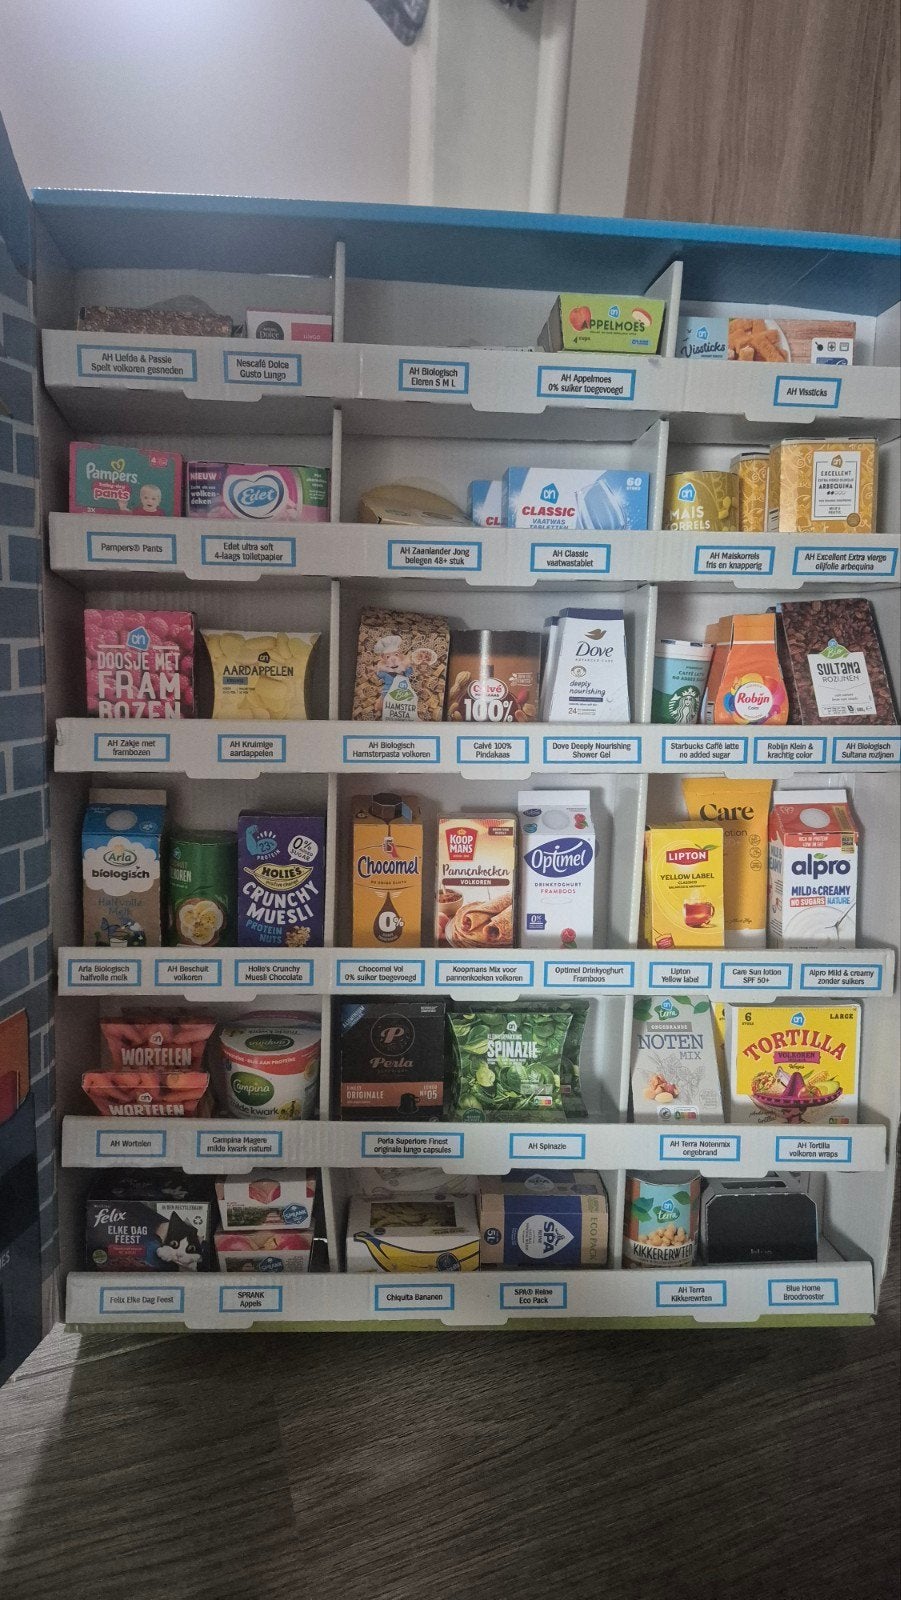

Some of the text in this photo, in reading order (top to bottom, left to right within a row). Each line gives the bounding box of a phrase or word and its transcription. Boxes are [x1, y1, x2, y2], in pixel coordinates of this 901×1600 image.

[581, 319, 645, 333] APPELMOES
[681, 343, 726, 358] Vissticks
[239, 370, 286, 381] Gusto Lungo
[560, 374, 611, 384] AH Appelmoes
[560, 384, 582, 392] suiker
[583, 385, 623, 395] toegevoegd
[798, 388, 827, 396] Vissticks
[86, 462, 138, 484] Pampers
[190, 472, 217, 481] NIEUW
[627, 478, 642, 487] 60
[94, 488, 131, 501] pants
[241, 487, 274, 503] Edet
[521, 506, 576, 517] CLASSIC
[670, 506, 704, 520] MAIS
[452, 547, 469, 556] Jong
[564, 550, 588, 558] Classic
[242, 553, 283, 562] toiletpapier
[405, 557, 432, 566] belegen
[449, 557, 464, 565] stuk
[546, 559, 593, 567] vaatwastablet
[575, 640, 614, 658] Dove
[98, 651, 180, 670] DOOSJE MET
[223, 665, 294, 677] AARDAPPELEN
[822, 675, 860, 683] ROZIJNEN
[99, 672, 181, 700] FRAM
[569, 680, 591, 689] deeply
[569, 686, 606, 697] nourishing
[737, 692, 770, 706] Robijn
[99, 701, 181, 719] BOZEN
[385, 702, 417, 712] HAMSTER
[464, 699, 513, 722] 100%
[389, 710, 416, 719] PASTA
[120, 740, 139, 749] Zakje
[242, 741, 272, 749] Kruimige
[380, 742, 414, 751] Biologisch
[571, 742, 593, 751] Deeply
[595, 742, 630, 751] Nourishing
[767, 743, 787, 752] Robijn
[857, 743, 890, 751] Biologisch
[229, 749, 273, 758] aardappelen
[352, 750, 399, 759] Hamsterpasta
[767, 751, 794, 760] krachtig
[868, 752, 894, 760] rozijnen
[700, 803, 754, 822] Care
[449, 835, 473, 845] KOOP
[449, 843, 473, 854] MANS
[108, 851, 132, 862] Arla
[531, 840, 586, 874] Optimel
[669, 852, 706, 862] LIPTON
[358, 856, 418, 878] Chocomel
[442, 863, 510, 877] Pannenkoeken
[791, 854, 851, 879] alpro
[91, 868, 150, 881] biologisch
[661, 873, 690, 881] YELLOW
[242, 880, 319, 909] CRUNCHY
[791, 896, 851, 907] NO SUGARS NATURE
[246, 906, 314, 925] MUESLI
[378, 912, 404, 930] 0%
[246, 920, 283, 936] PROTEIN
[259, 934, 282, 944] NUTS
[272, 965, 300, 974] Crunchy
[555, 966, 623, 975] Optimel Drinkyoghurt
[763, 968, 781, 976] lotion
[743, 976, 755, 984] SPF
[744, 1012, 752, 1022] 6
[638, 1034, 703, 1049] NOTEN
[743, 1029, 848, 1061] TORTILLA
[487, 1041, 538, 1059] SPINAZIE
[121, 1048, 192, 1067] WORTELEN
[680, 1051, 702, 1060] MIX
[369, 1057, 414, 1069] Perla
[233, 1079, 271, 1094] Campina
[346, 1091, 384, 1100] ORIGINALE
[109, 1104, 184, 1116] WORTELEN
[539, 1142, 566, 1151] Spinazie
[283, 1208, 308, 1220] SPRANK
[107, 1225, 148, 1236] ELKE DAG
[114, 1235, 142, 1245] FEEST
[543, 1221, 555, 1254] SPA
[633, 1243, 693, 1262] KIKKERERWTEN
[786, 1284, 820, 1292] Blue Home
[237, 1291, 264, 1299] SPRANK
[386, 1293, 413, 1302] Chiquita
[783, 1293, 824, 1301] Broodrooster
[240, 1300, 261, 1309] Appels
